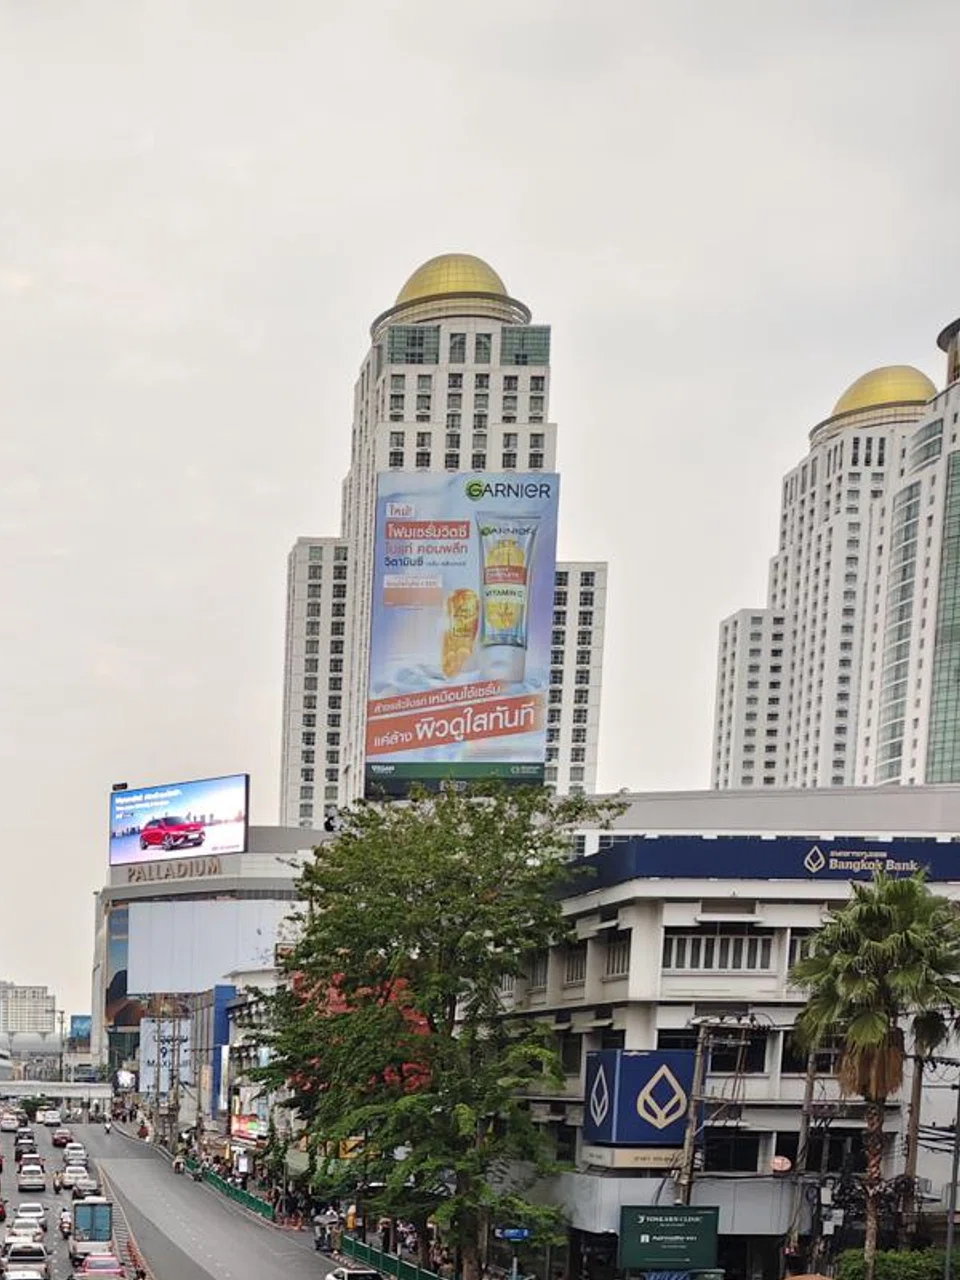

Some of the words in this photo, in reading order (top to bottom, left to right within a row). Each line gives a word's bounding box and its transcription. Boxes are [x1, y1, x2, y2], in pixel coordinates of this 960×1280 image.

[467, 482, 551, 500] GARNIER
[128, 856, 221, 882] PALLADIUM
[829, 859, 883, 872] Bangkok
[886, 859, 918, 870] Bank
